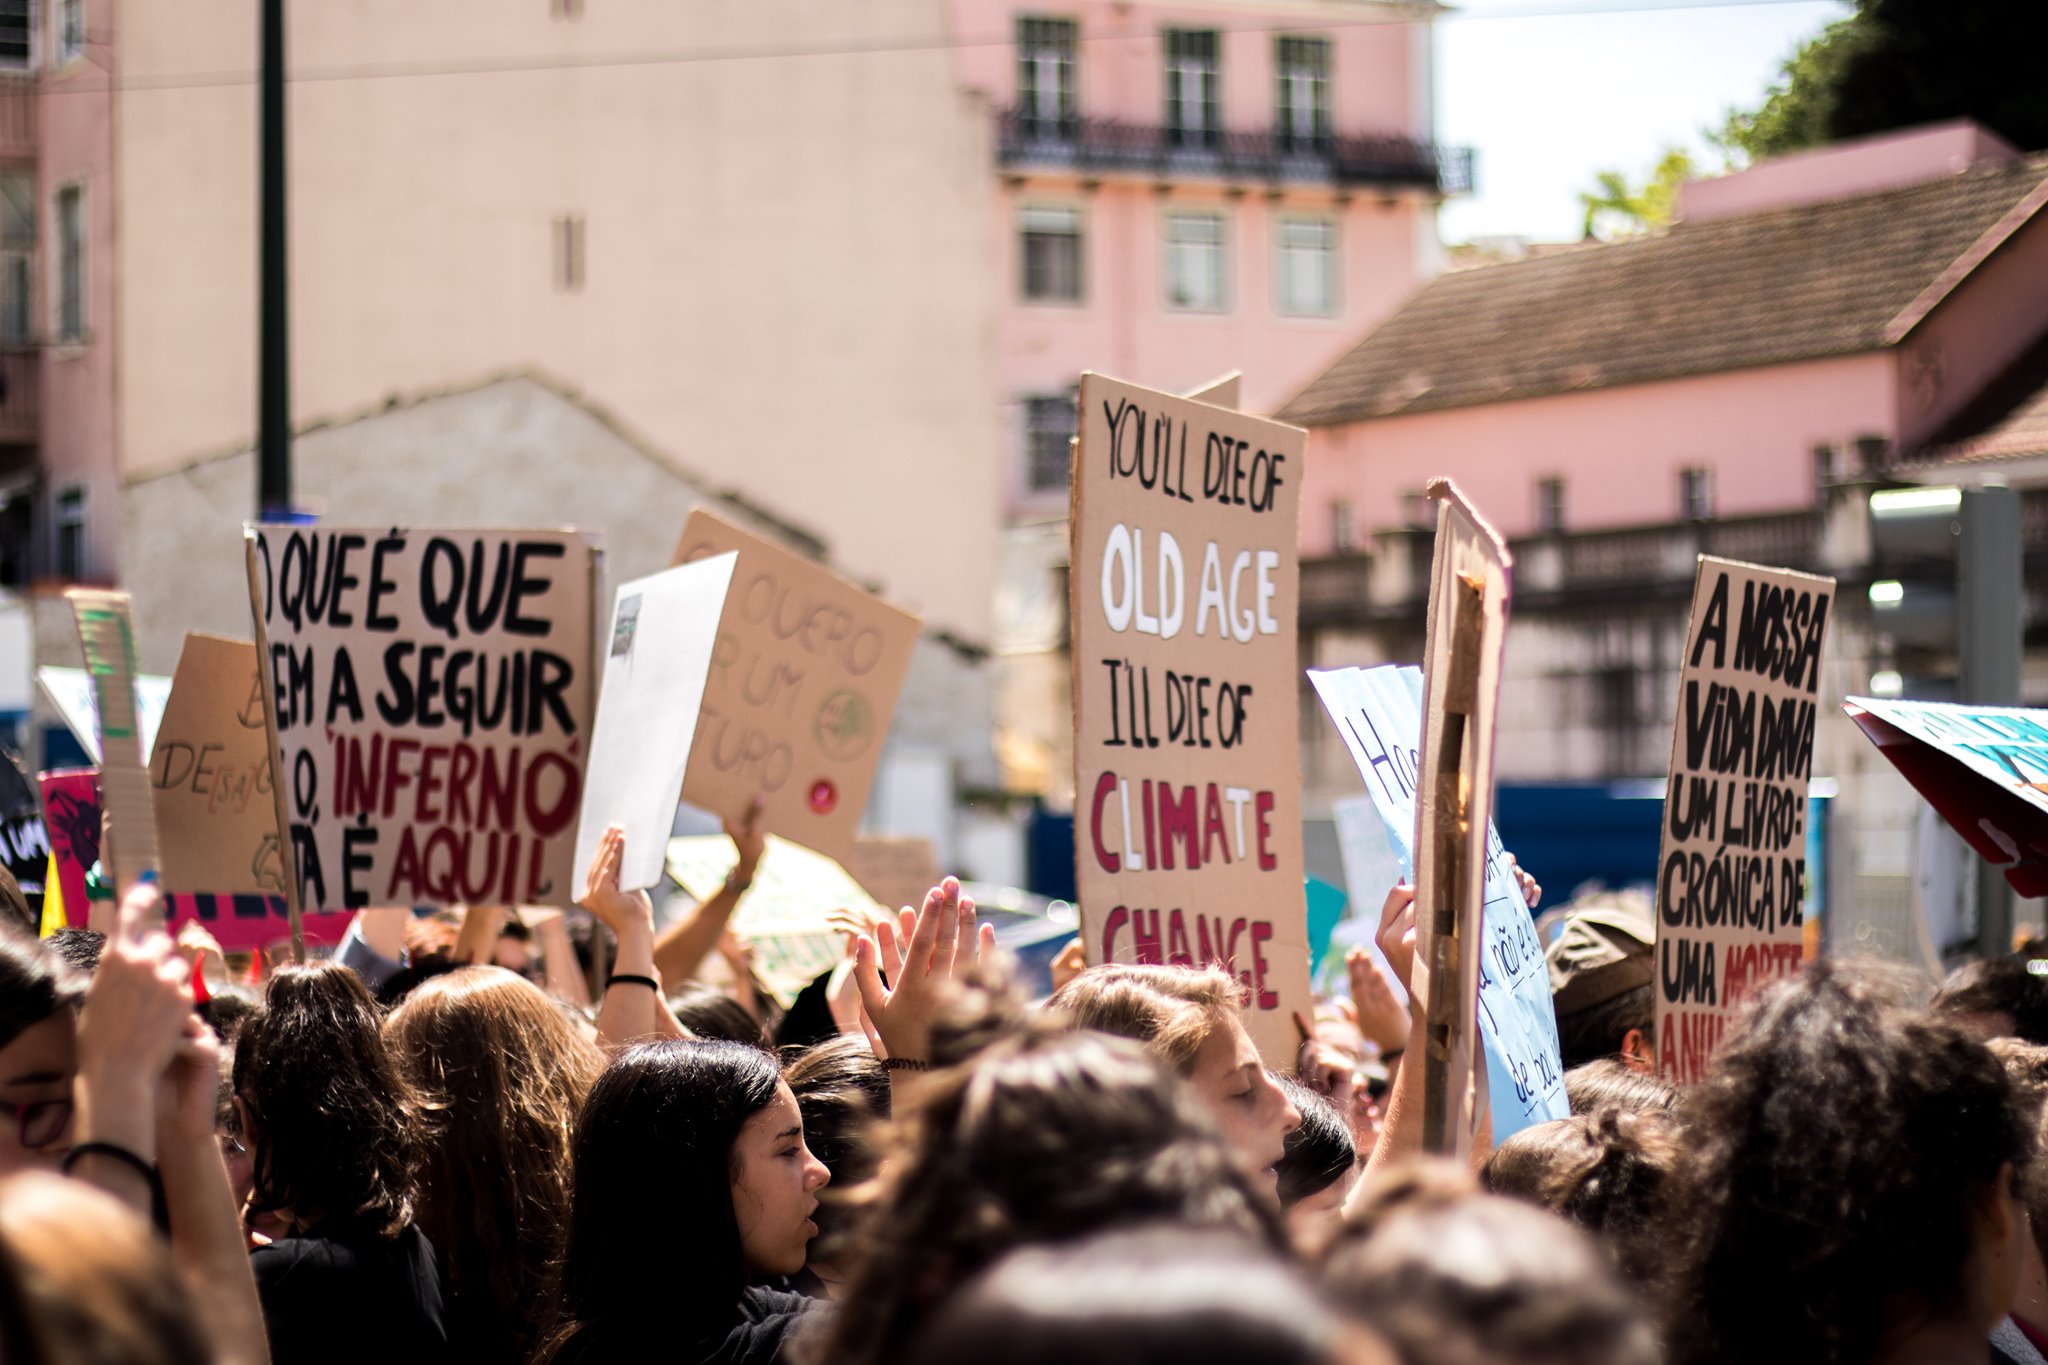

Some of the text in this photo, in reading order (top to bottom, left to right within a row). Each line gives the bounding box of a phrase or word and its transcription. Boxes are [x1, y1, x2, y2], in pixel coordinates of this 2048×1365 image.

[1104, 398, 1285, 513] YOU'LL DIE OF
[279, 530, 366, 634] QUE
[366, 527, 411, 631] É
[420, 536, 566, 640] QUE
[1101, 522, 1278, 643] OLD AGE
[1690, 572, 1829, 694] A NOSSA
[270, 642, 314, 733] EM
[326, 645, 365, 730] A
[375, 640, 577, 738] SEGUIR
[1102, 658, 1253, 749] I'LL DIE OF
[1754, 694, 1817, 783] DAVA
[1091, 771, 1277, 873] CLIMATE
[1671, 773, 1718, 842] UM
[342, 812, 378, 909] É
[387, 824, 552, 905] AQUI!
[1780, 857, 1806, 927] DE
[1661, 938, 1717, 1006] UMA
